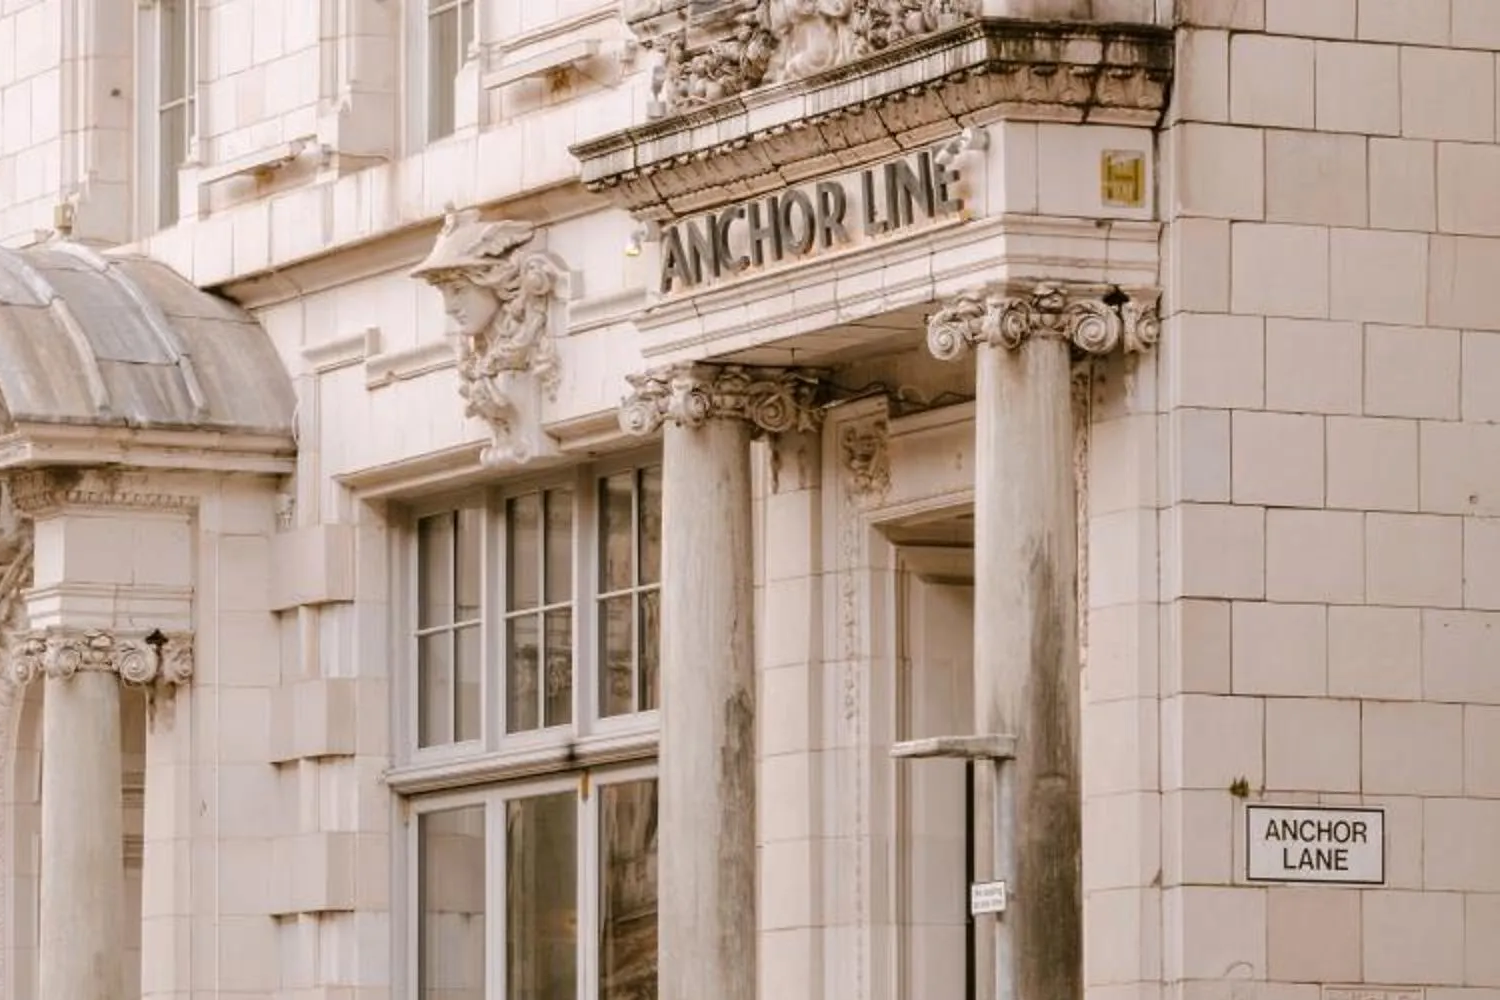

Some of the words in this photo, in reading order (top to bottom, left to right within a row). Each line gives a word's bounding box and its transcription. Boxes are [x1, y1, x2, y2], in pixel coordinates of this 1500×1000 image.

[659, 180, 850, 293] ANCHOR
[860, 149, 965, 236] LINE
[1265, 819, 1368, 843] ANCHOR
[1283, 847, 1349, 871] LANE
